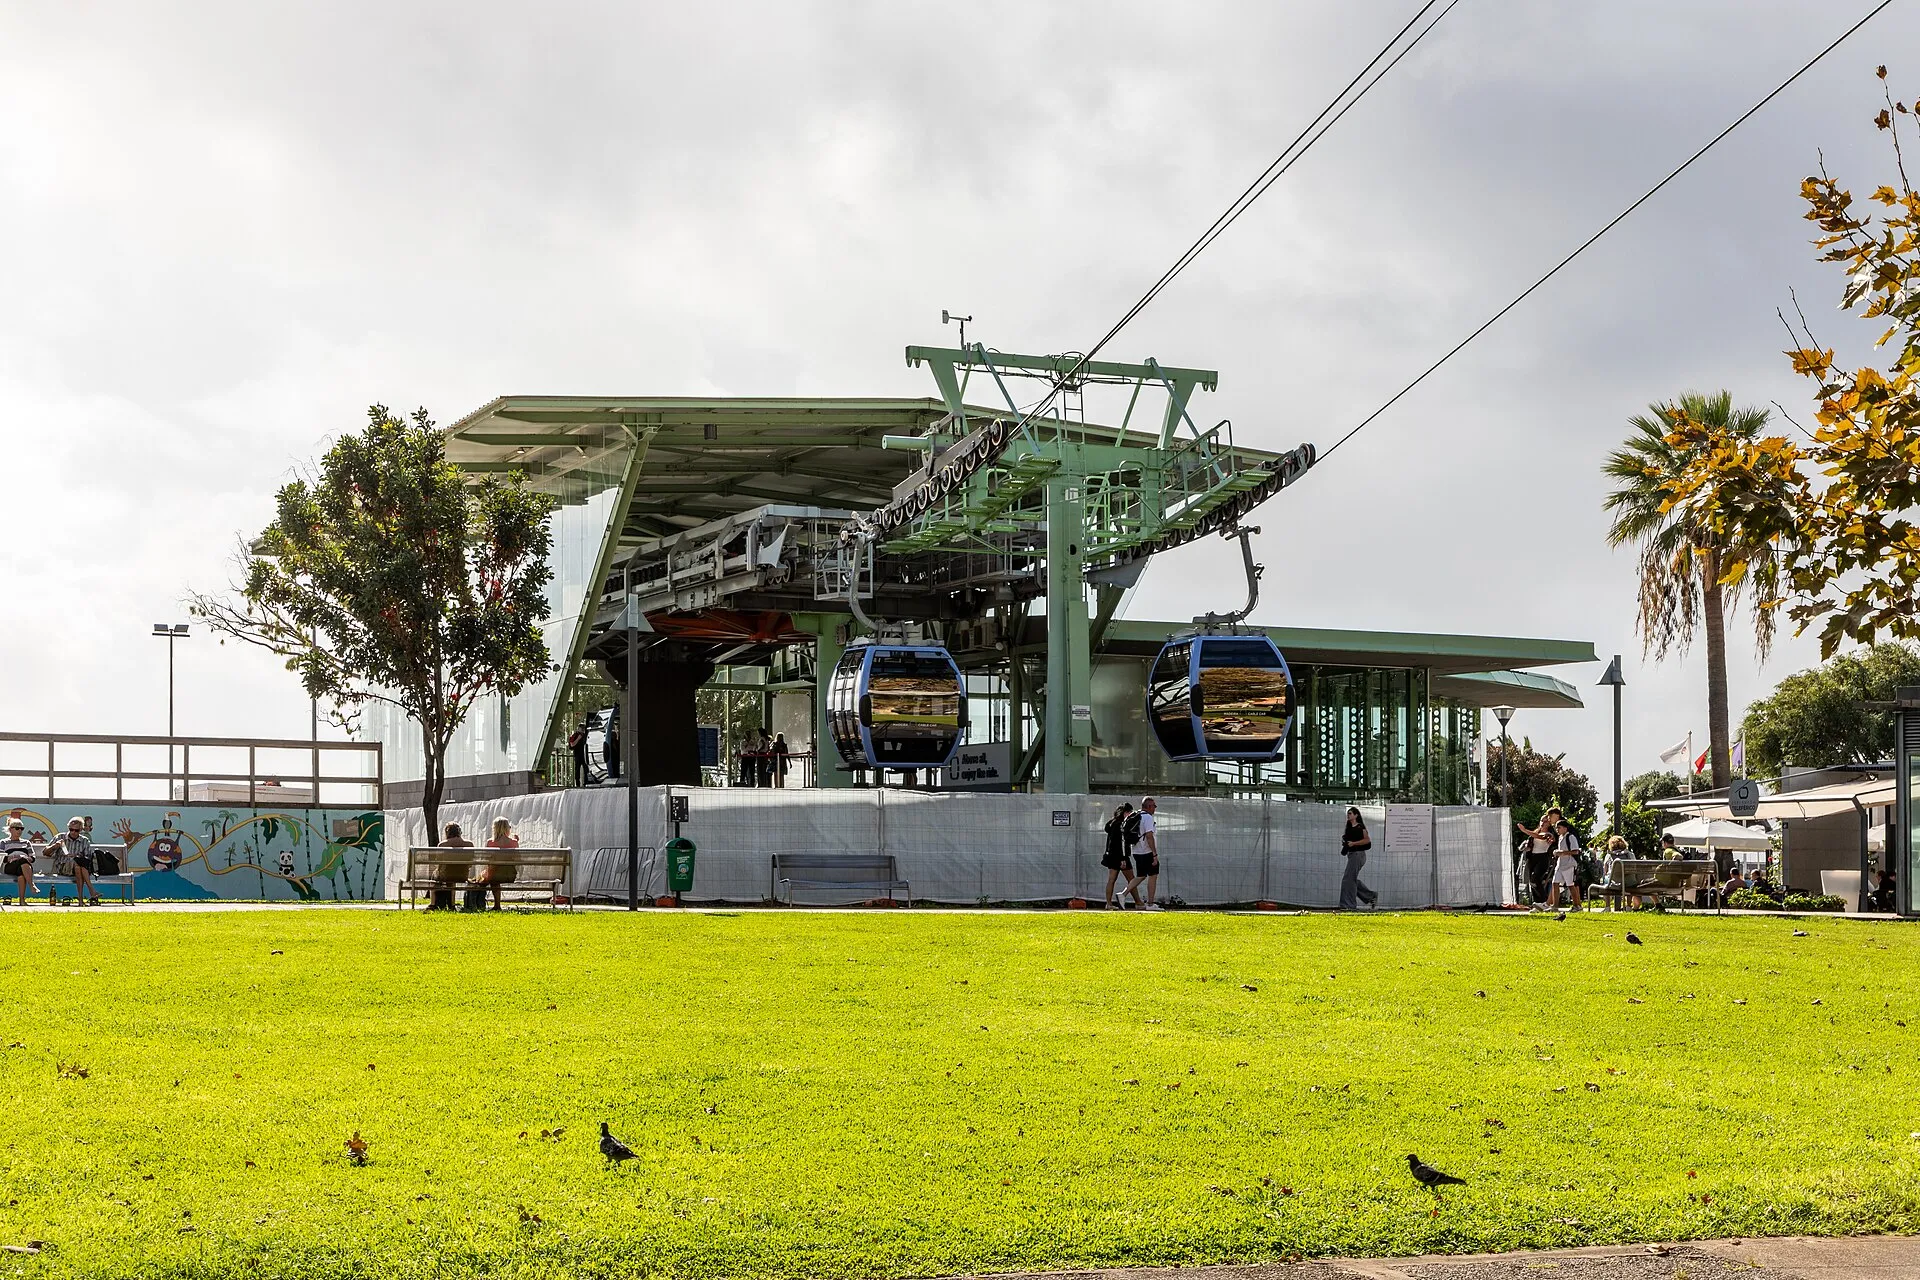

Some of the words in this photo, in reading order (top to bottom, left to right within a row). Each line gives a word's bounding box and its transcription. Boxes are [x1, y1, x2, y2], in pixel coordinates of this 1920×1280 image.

[962, 754, 979, 764] Above
[979, 753, 988, 765] all,
[961, 768, 977, 781] enjoy
[977, 768, 986, 778] the
